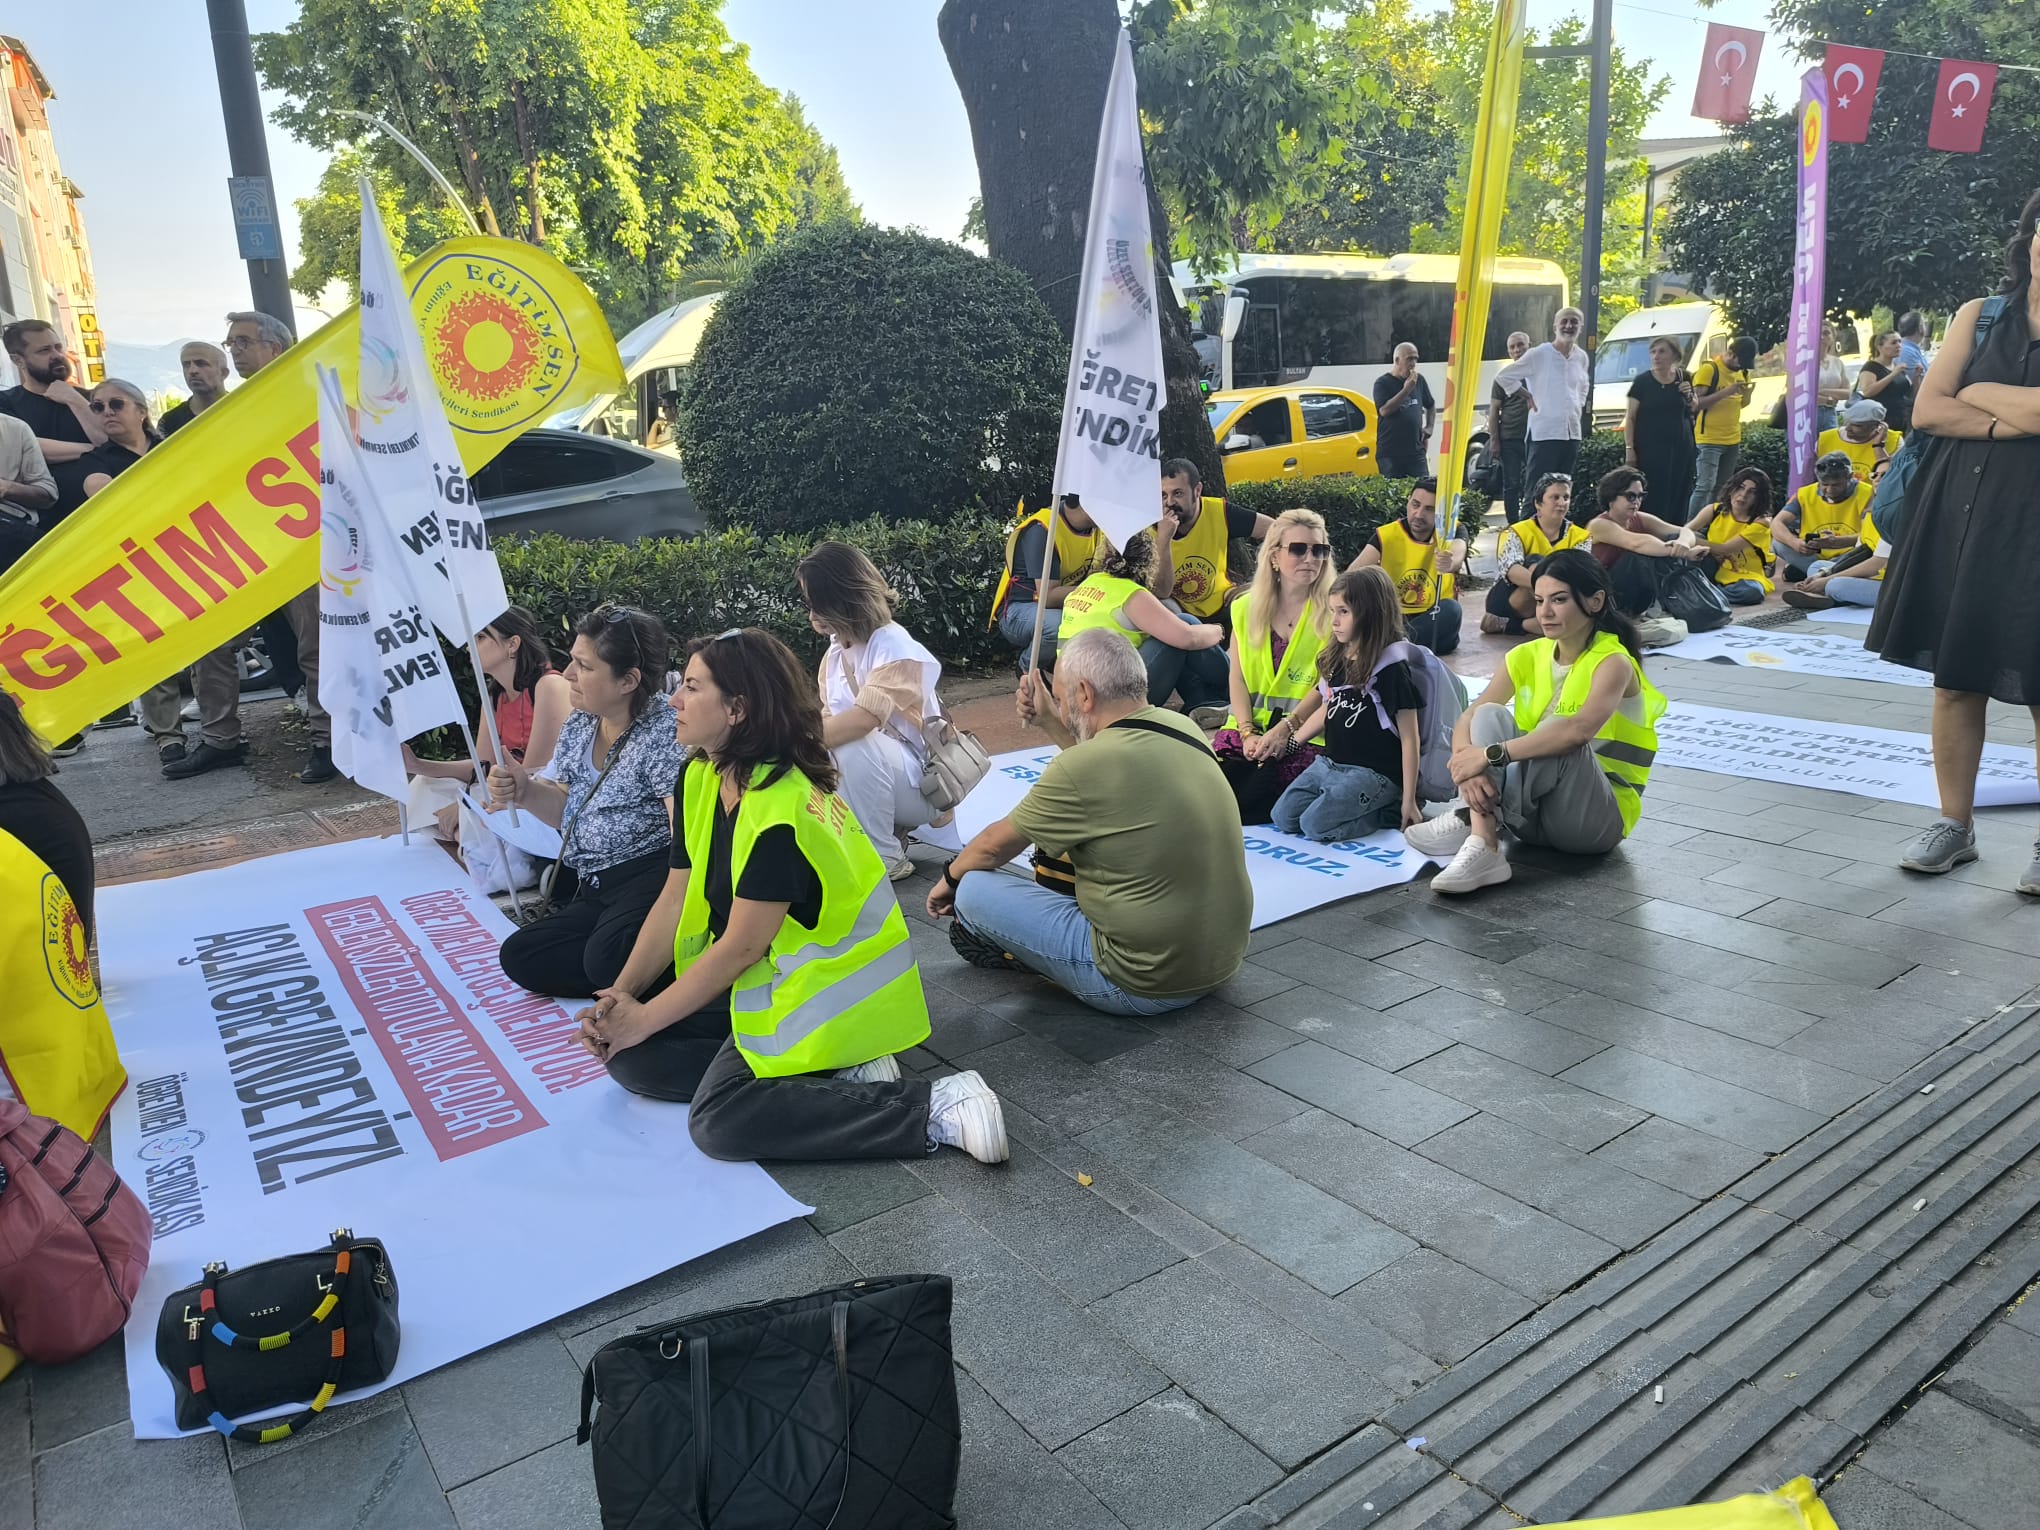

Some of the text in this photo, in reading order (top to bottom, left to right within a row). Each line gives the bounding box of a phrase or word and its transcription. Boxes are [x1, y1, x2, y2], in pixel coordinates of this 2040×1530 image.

[466, 263, 565, 399] EĞİTİM SEN
[471, 399, 520, 419] Sendikası
[1076, 406, 1160, 460] NDİK
[0, 500, 268, 708] ĞİTİM
[177, 922, 414, 1195] AÇLIK GREVİNDEYİZ!
[320, 901, 524, 1142] VERİLEN SÖZLER TUTULANA KADAR
[135, 1070, 209, 1240] ÖĞRETMEN SENDİKASI
